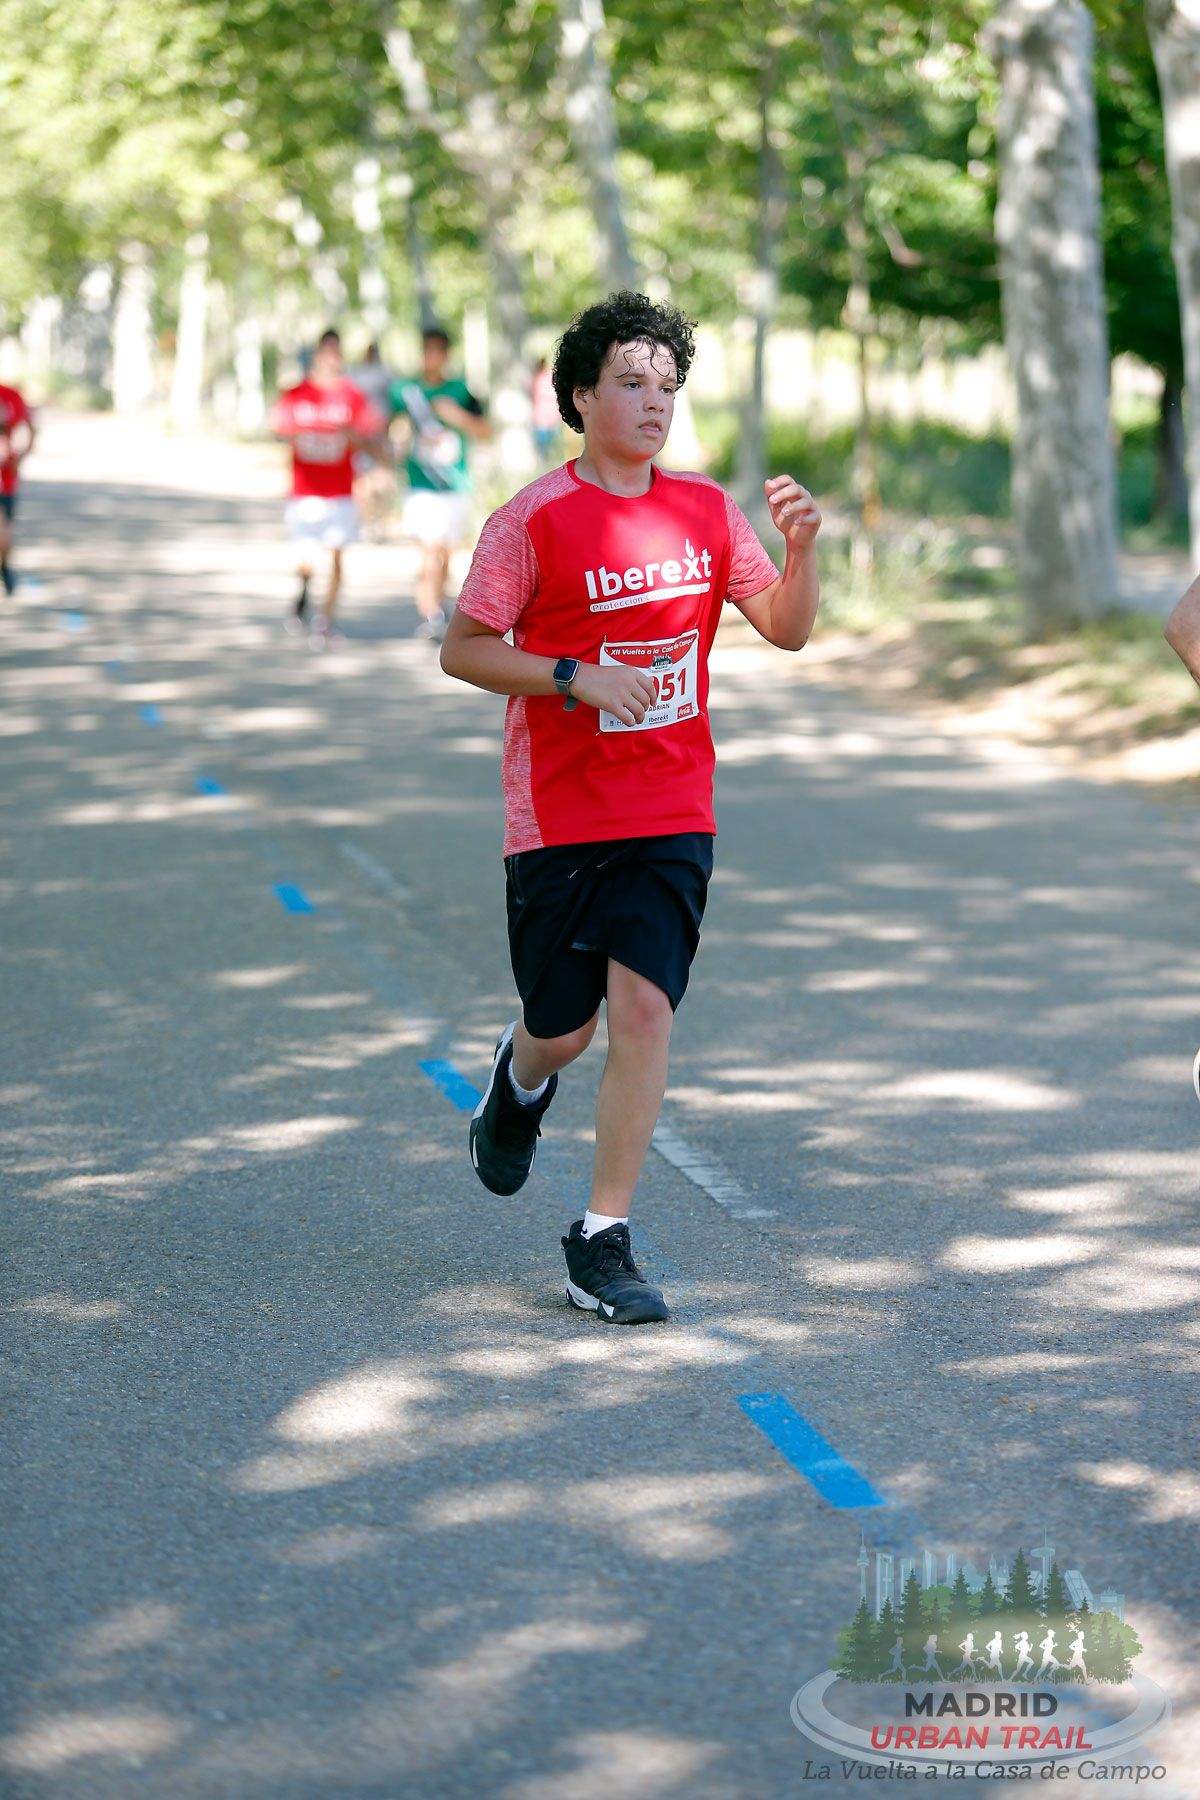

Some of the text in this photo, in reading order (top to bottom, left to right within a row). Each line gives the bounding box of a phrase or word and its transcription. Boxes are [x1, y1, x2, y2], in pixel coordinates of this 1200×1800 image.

[585, 548, 712, 599] Iberext
[592, 596, 643, 612] Protección
[661, 645, 674, 653] Casa
[648, 714, 669, 723] Iberext
